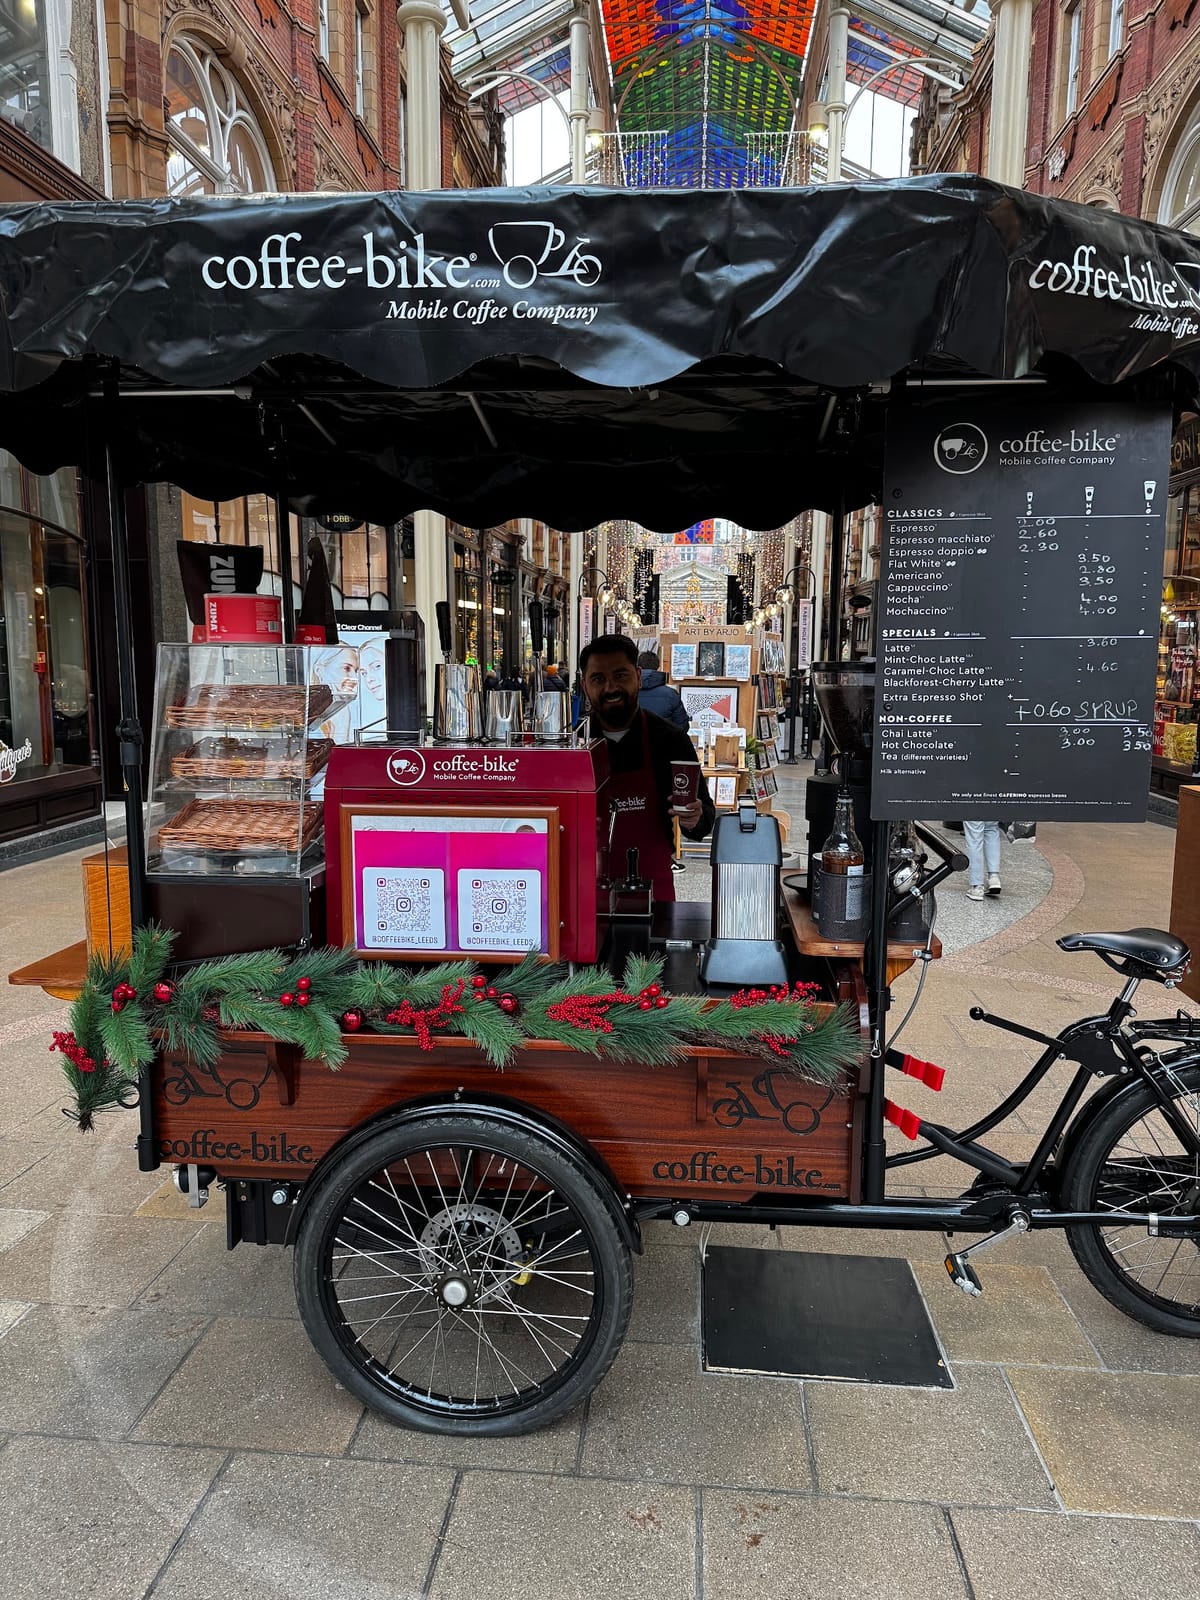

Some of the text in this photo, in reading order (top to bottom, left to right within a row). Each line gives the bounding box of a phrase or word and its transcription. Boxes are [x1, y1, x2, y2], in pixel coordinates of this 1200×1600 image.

[386, 299, 599, 325] Mobile Coffee Company
[1129, 314, 1171, 332] Mobile
[1000, 456, 1116, 467] Mobile Coffee Company
[887, 509, 943, 518] CLASSICS
[890, 524, 935, 534] Espresso
[889, 534, 991, 546] Espresso macchiato
[889, 547, 974, 558] Espresso doppio
[1018, 542, 1059, 553] 2.30
[1077, 553, 1110, 563] 3.50
[888, 559, 941, 568] Flat White
[887, 572, 942, 580] Americano
[1079, 577, 1114, 587] 3.50
[887, 583, 949, 593] Cappuccino
[887, 595, 920, 604] Mocha
[209, 601, 218, 631] ZUMA
[886, 606, 947, 616] Mochaccino
[882, 629, 936, 637] SPECIALS
[885, 644, 911, 653] Latte
[884, 655, 966, 664] Mint-Choc Latte
[884, 667, 985, 675] Caramel-Choc Latte
[883, 678, 1005, 688] Blackforest-Cherry Latte
[883, 693, 983, 703] Extra Espresso Shot
[1074, 700, 1138, 719] SYRUP
[879, 715, 953, 723] NON-COFFEE
[881, 729, 933, 738] Chai Latte
[1122, 726, 1153, 738] 3.50
[881, 740, 954, 749] Hot Chocolate
[881, 752, 898, 760] Tea
[483, 774, 516, 782] Company
[372, 936, 438, 945] @COFFEEBIKE_LEEDS
